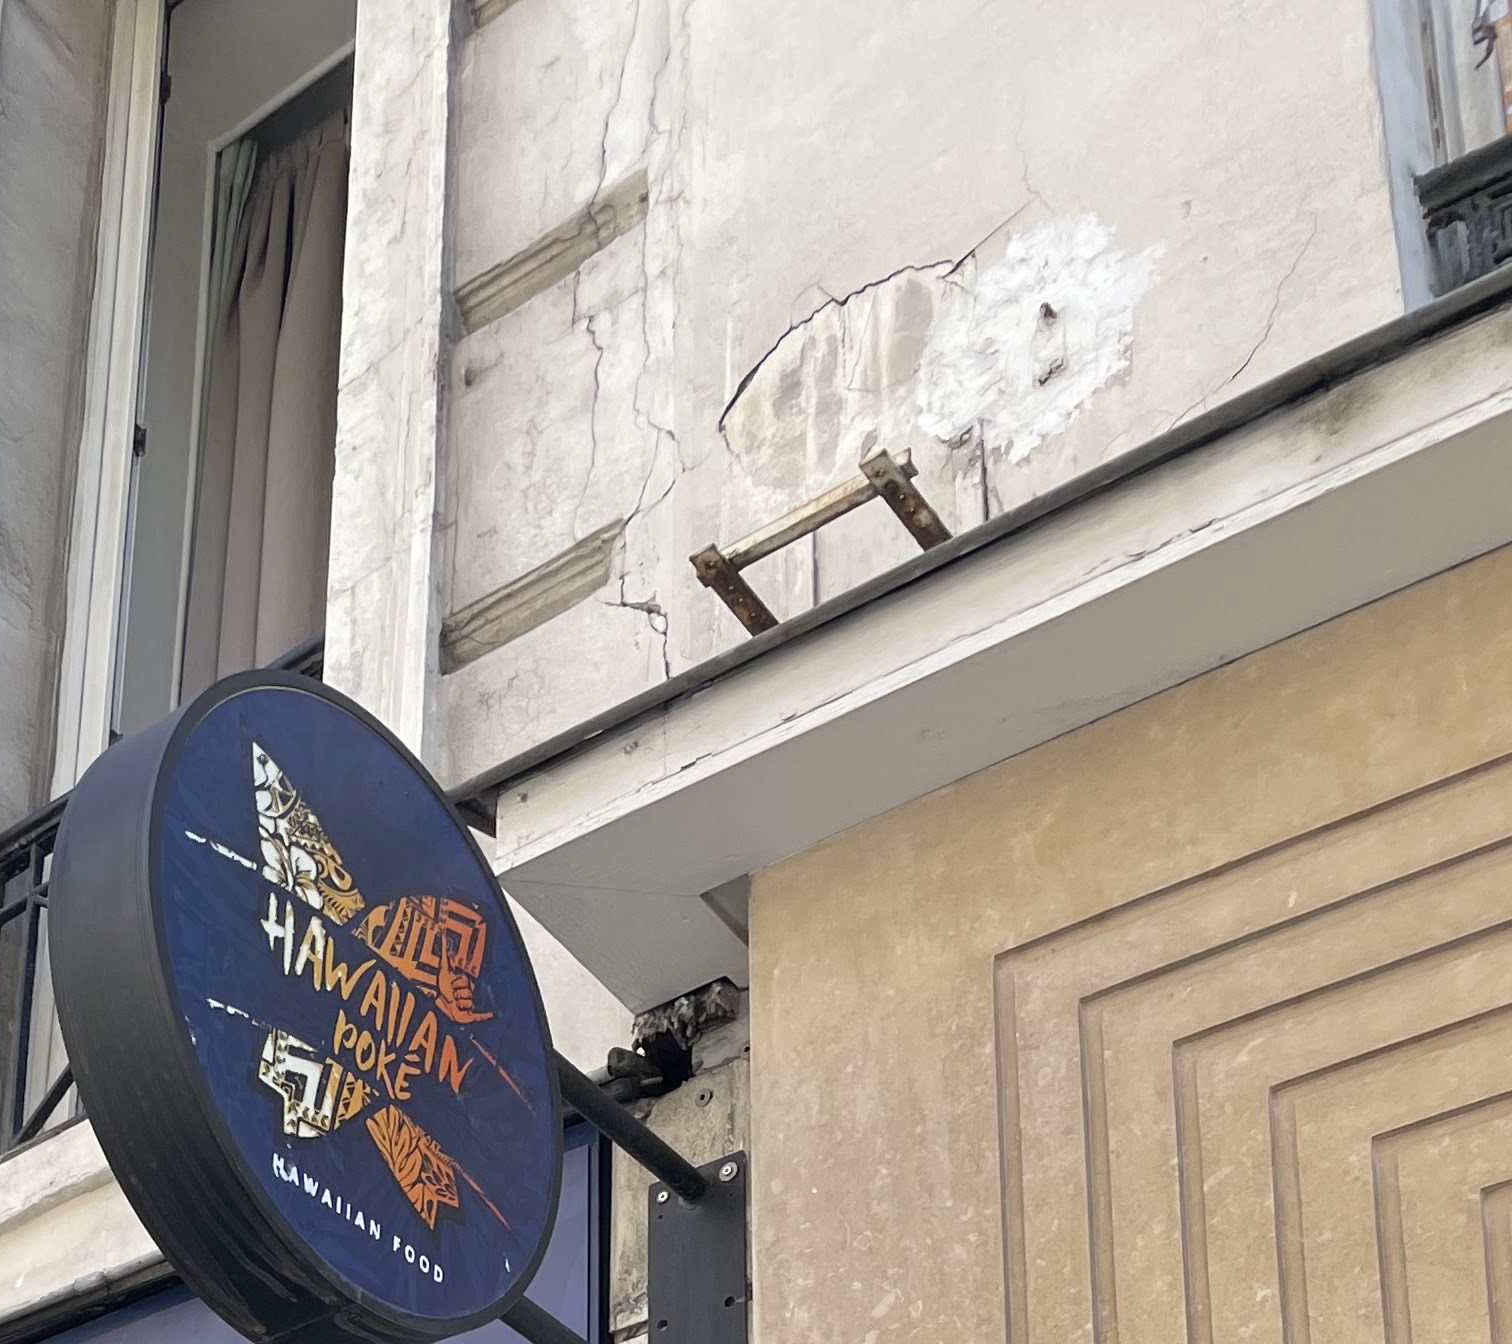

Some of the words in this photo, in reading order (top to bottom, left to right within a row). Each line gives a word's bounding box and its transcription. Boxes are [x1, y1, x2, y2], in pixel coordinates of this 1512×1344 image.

[260, 892, 475, 1093] HAWAIIAN
[334, 1009, 423, 1101] POKÉ
[272, 1152, 382, 1240] HAWAIIAN
[392, 1234, 445, 1283] FOOD
